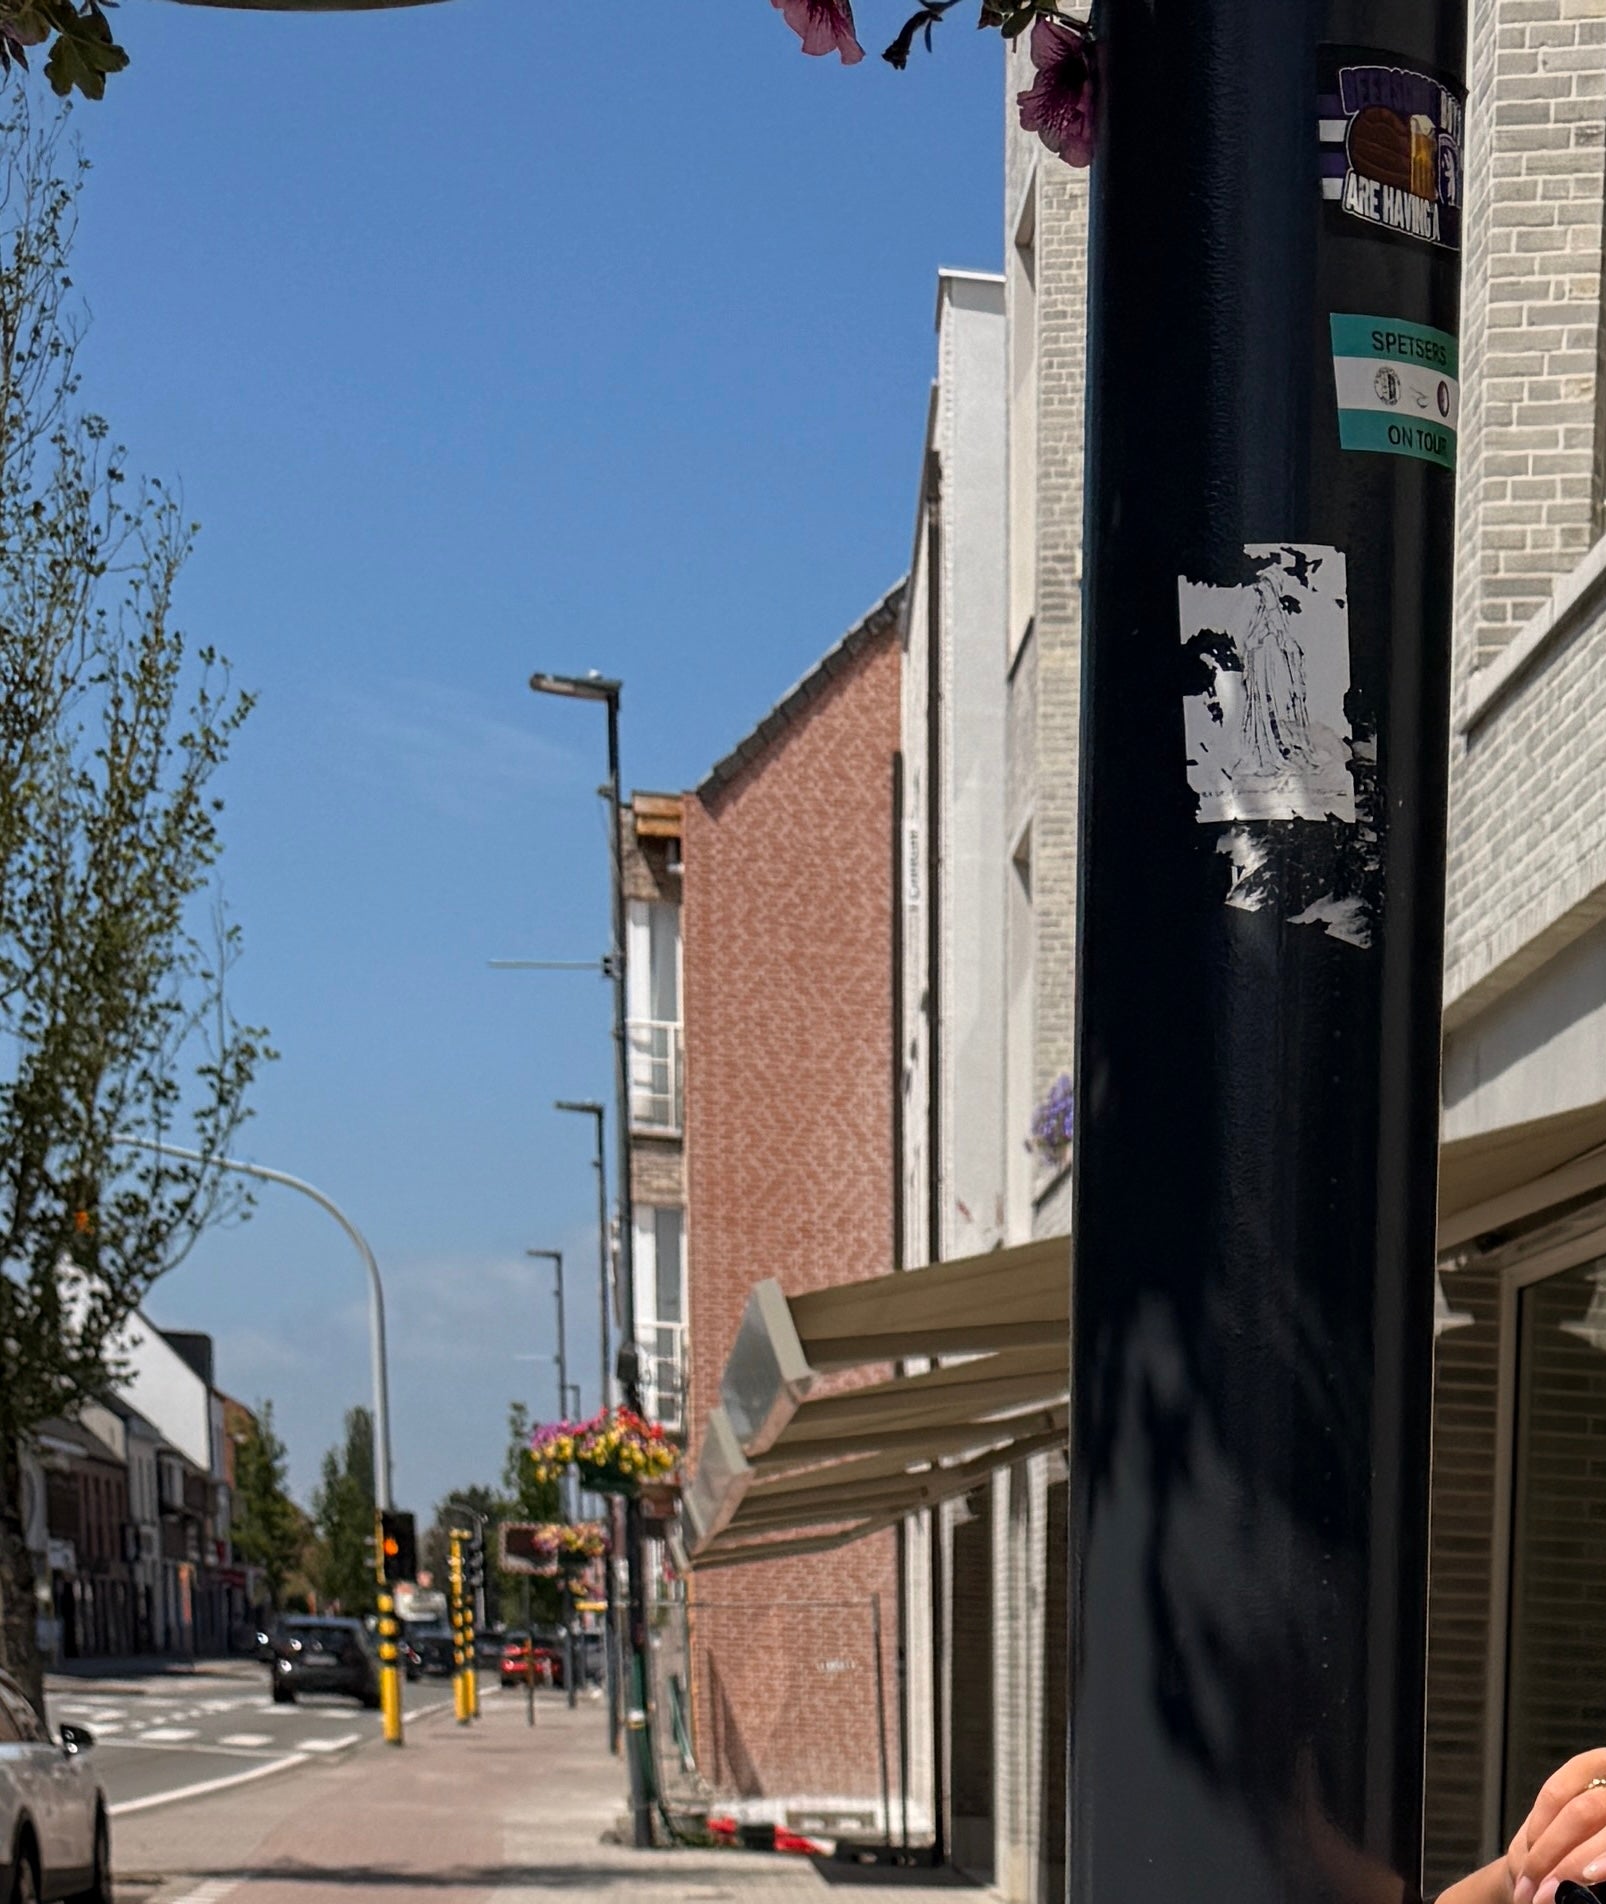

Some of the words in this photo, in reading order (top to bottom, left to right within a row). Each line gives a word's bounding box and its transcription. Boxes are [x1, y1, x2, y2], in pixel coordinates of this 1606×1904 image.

[1345, 172, 1381, 221] ARE
[1382, 184, 1432, 238] HAVING
[1371, 330, 1448, 367] SPETSERS
[1388, 424, 1413, 449] ON
